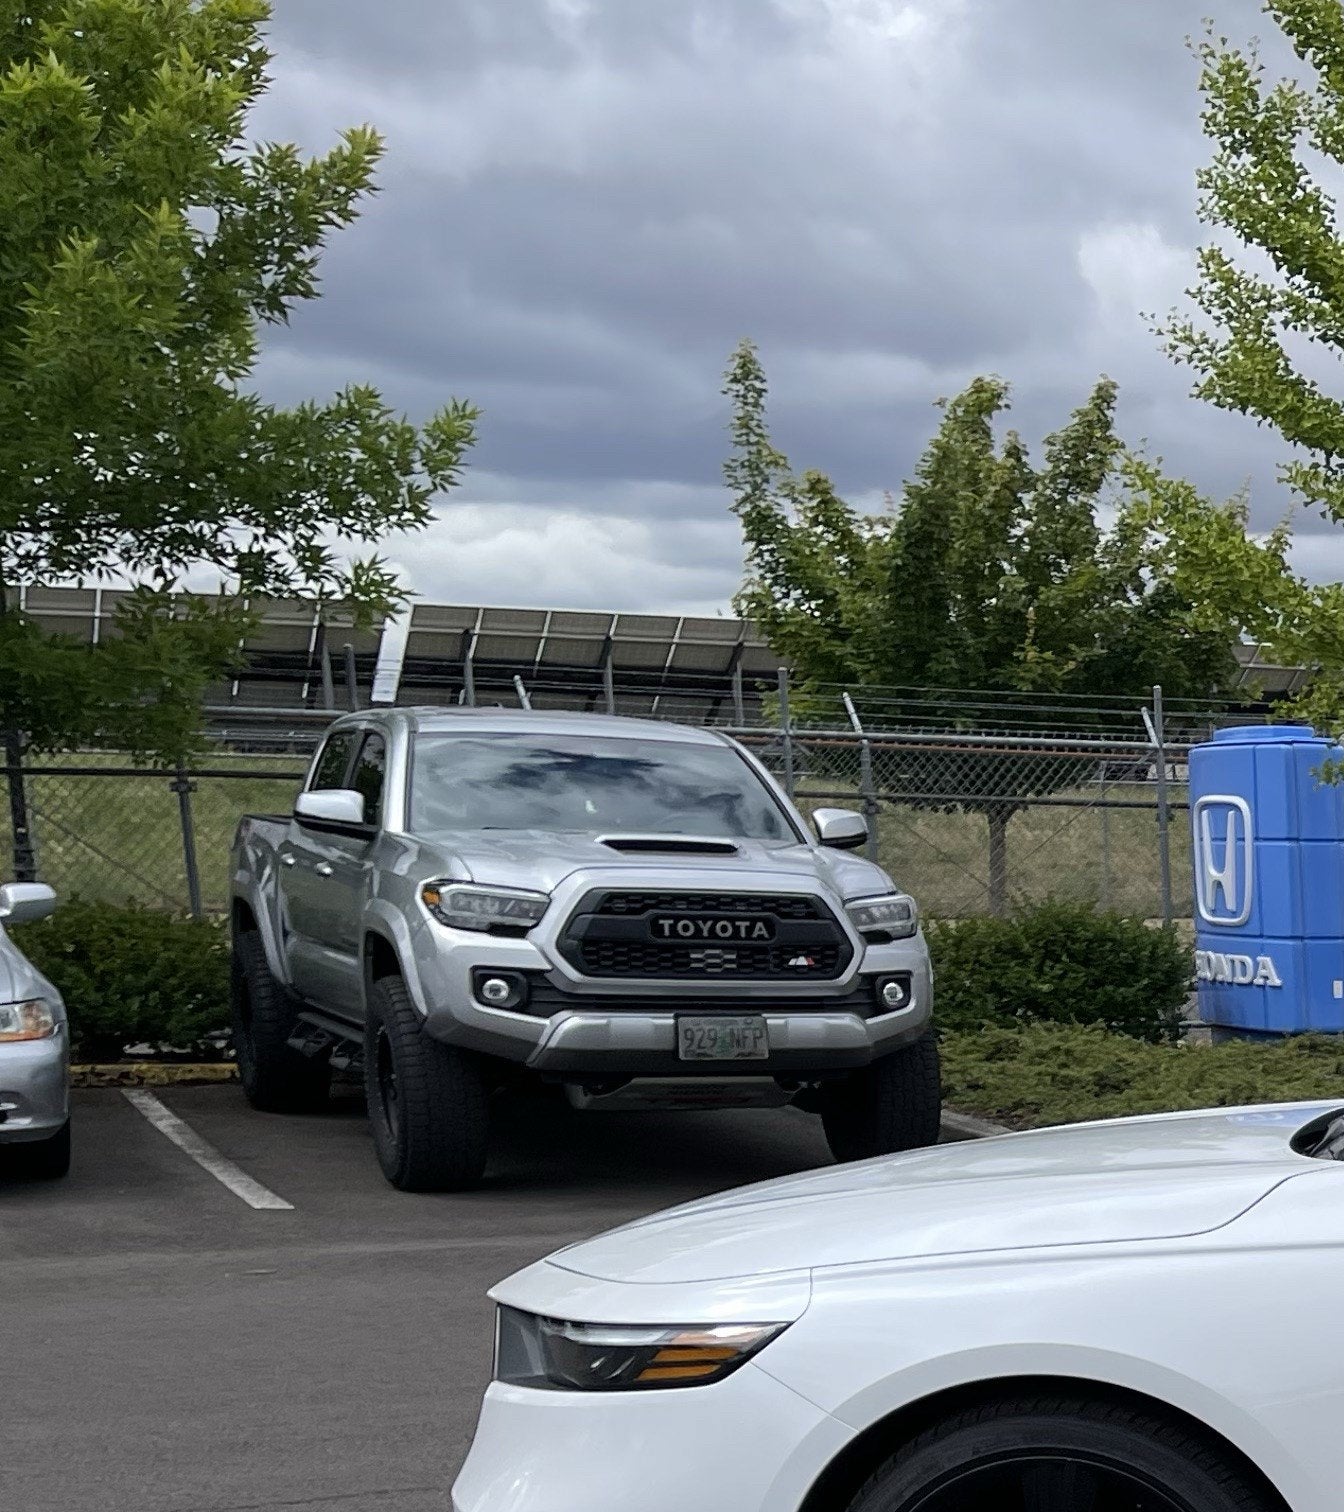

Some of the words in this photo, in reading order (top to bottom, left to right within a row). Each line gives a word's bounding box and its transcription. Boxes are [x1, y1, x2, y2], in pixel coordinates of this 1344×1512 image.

[658, 919, 770, 939] TOYOTA
[683, 1027, 718, 1050] 929
[729, 1027, 764, 1050] NFP
